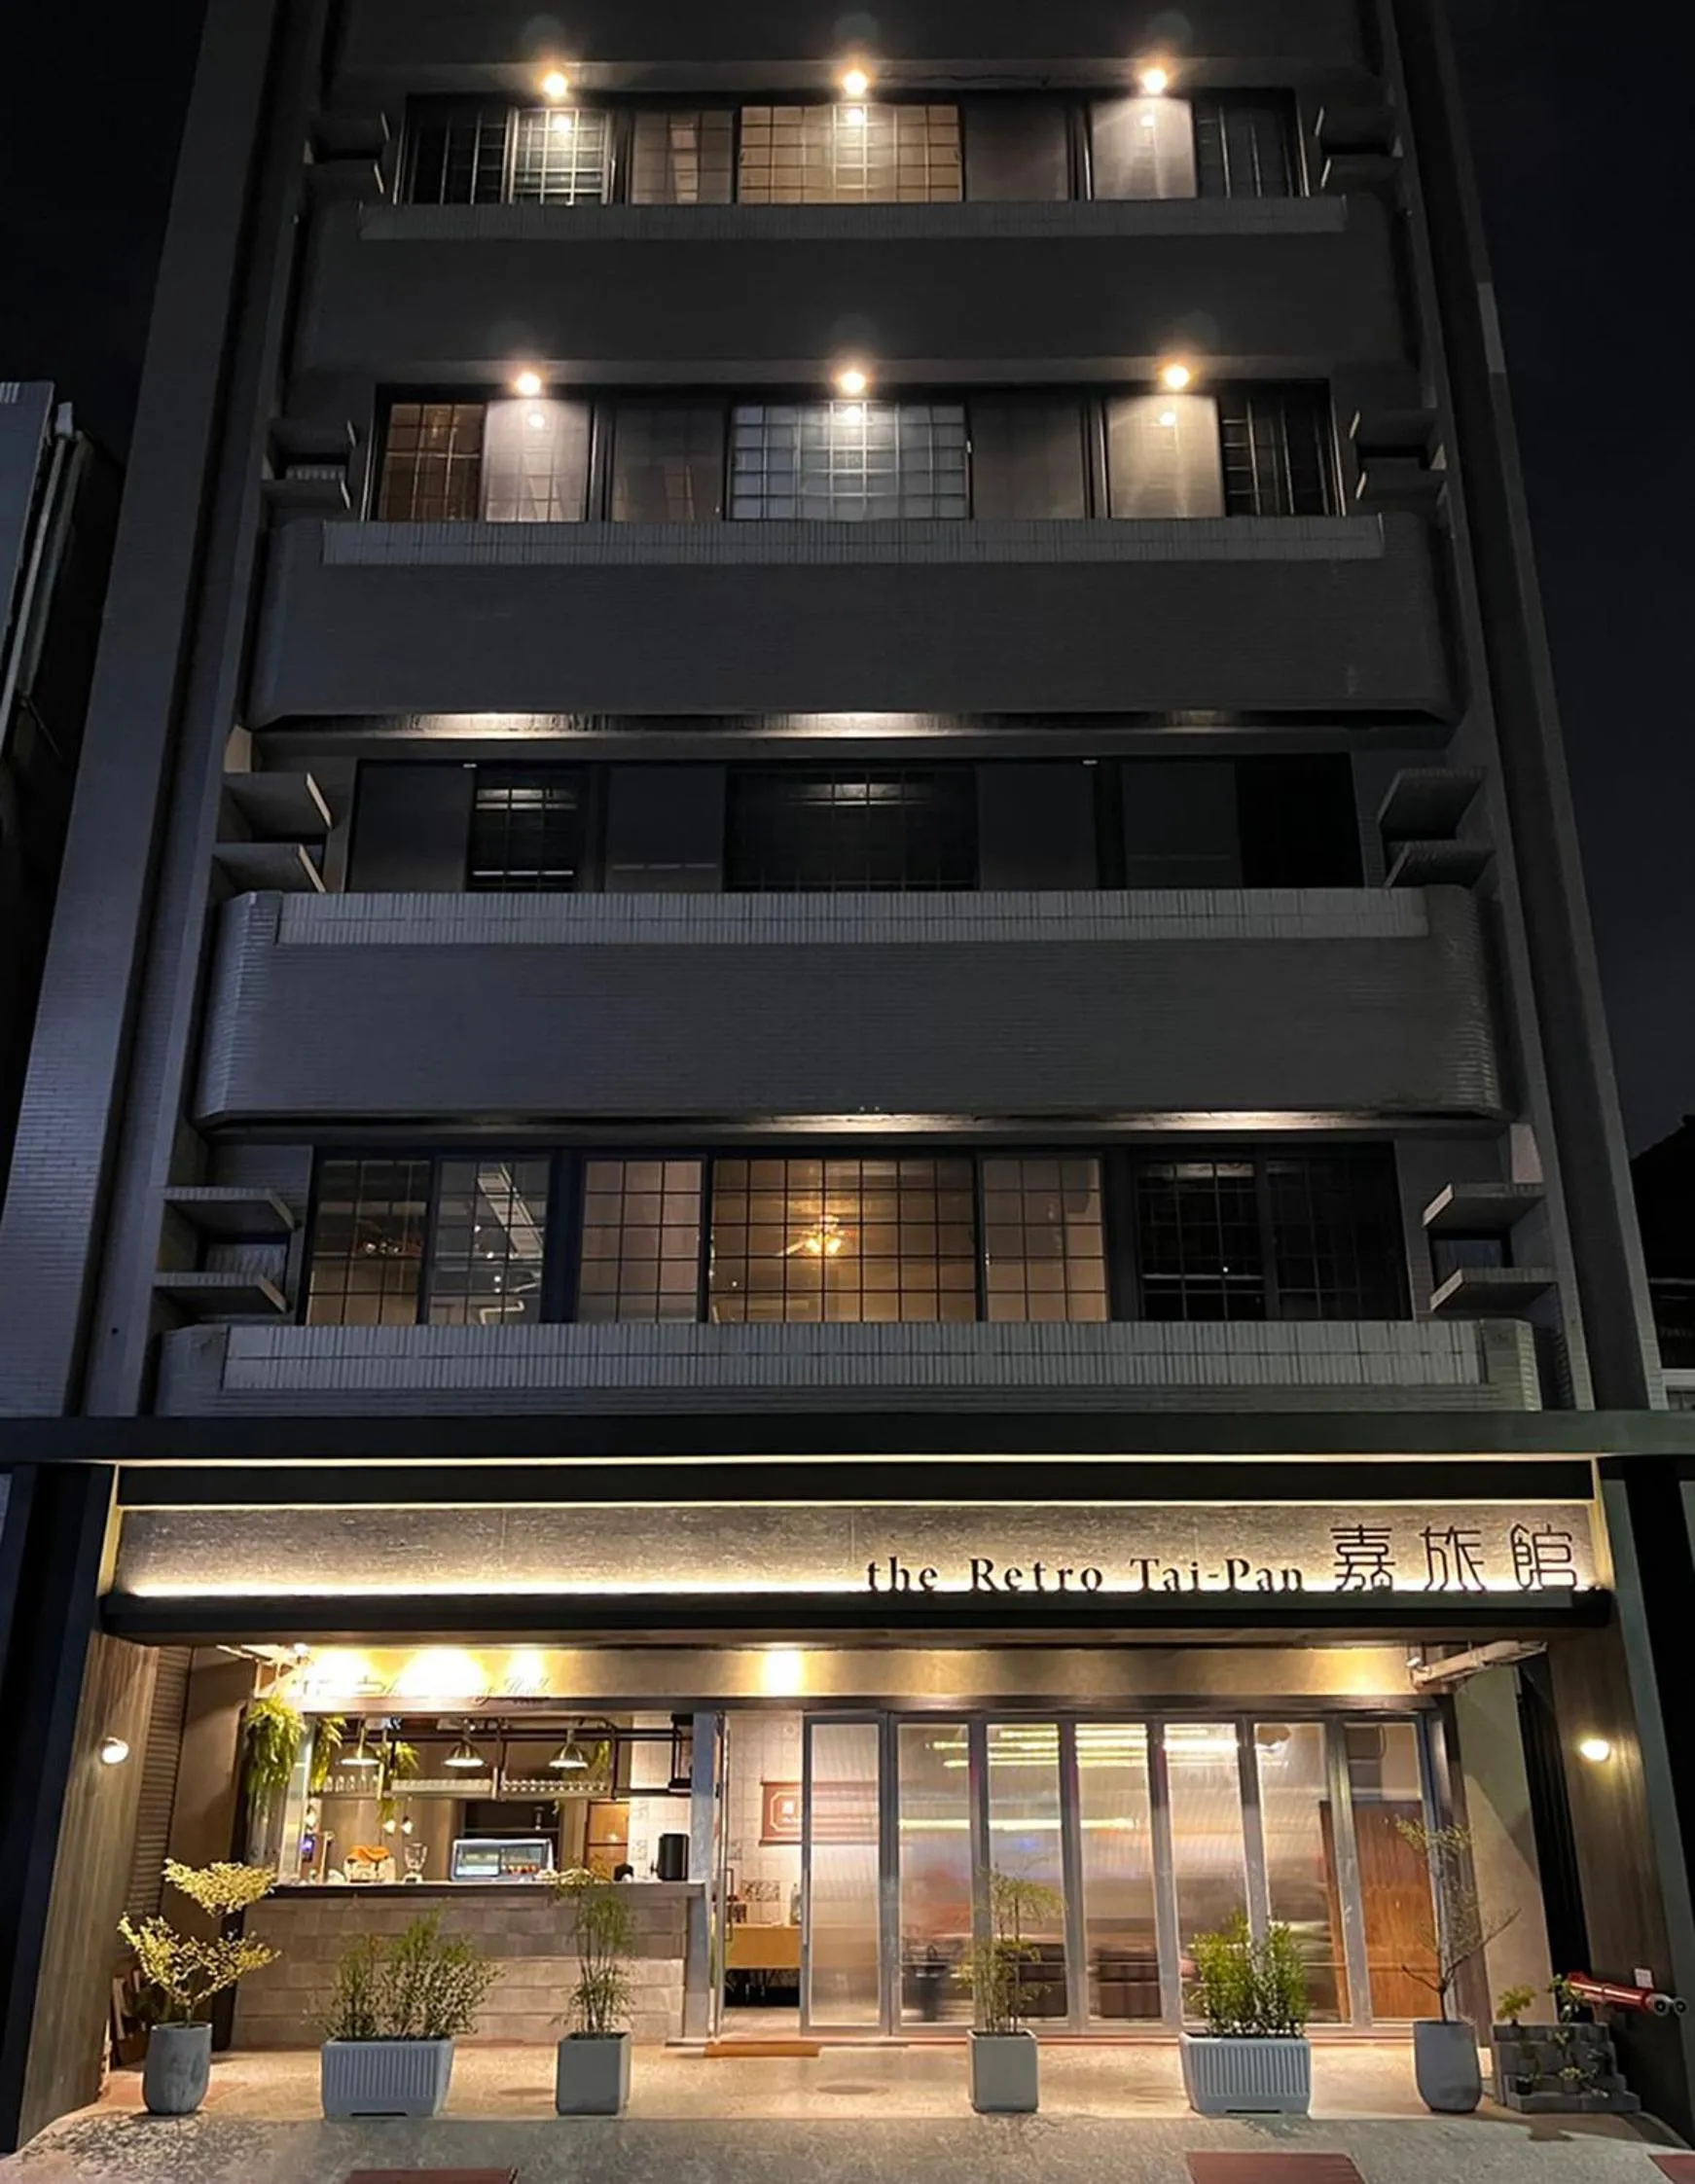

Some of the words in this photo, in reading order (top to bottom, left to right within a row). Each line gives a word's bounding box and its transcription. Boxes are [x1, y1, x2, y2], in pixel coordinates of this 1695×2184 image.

[867, 1557, 939, 1593] the
[968, 1557, 1103, 1593] Retro
[1130, 1557, 1305, 1593] Tai-Pan
[1330, 1523, 1577, 1593] 嘉旅館
